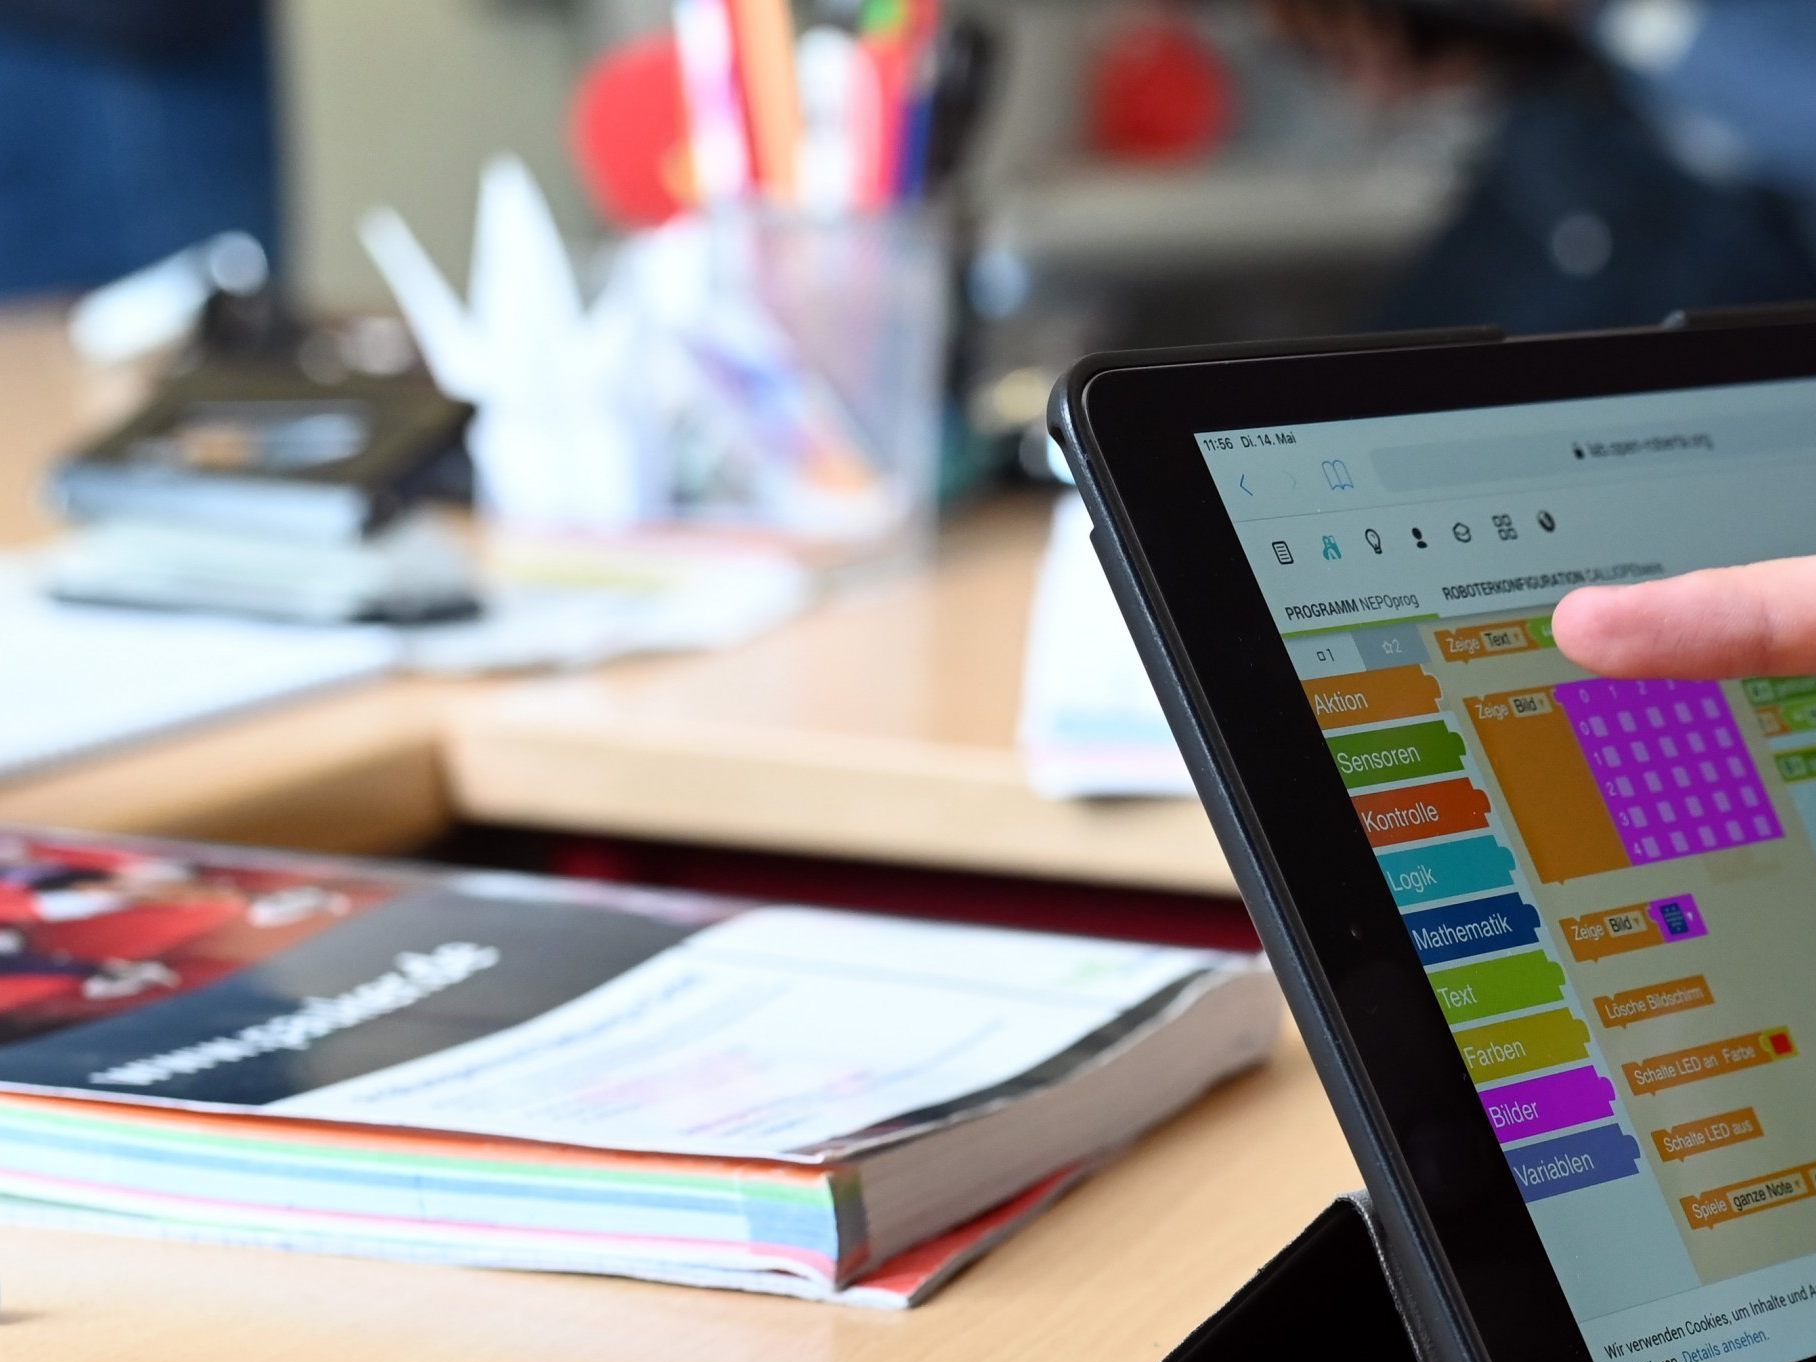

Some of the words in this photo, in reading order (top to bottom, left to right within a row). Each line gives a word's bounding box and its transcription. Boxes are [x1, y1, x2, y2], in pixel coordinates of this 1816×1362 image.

[1203, 437, 1234, 452] 11:56
[1240, 434, 1257, 448] Di.
[1257, 433, 1276, 447] 14.
[1275, 431, 1297, 445] Mai
[1442, 570, 1586, 601] ROBOTERKONFIGURATION
[1285, 599, 1360, 621] PROGRAMM
[1359, 594, 1420, 613] NEPOprog
[1447, 636, 1480, 655] Zeige
[1485, 631, 1512, 648] Text
[1314, 691, 1369, 716] Aktion
[1475, 701, 1510, 721] Zeige
[1512, 697, 1538, 714] Bild
[1337, 746, 1421, 774] Sensoren
[1361, 801, 1440, 833] Kontrolle
[1386, 864, 1438, 894] Logik
[1411, 912, 1514, 951] Mathematik
[1571, 921, 1605, 942] Zeige
[1607, 915, 1633, 934] Bild
[1437, 984, 1478, 1009] Text
[1605, 999, 1648, 1020] Lösche
[1645, 986, 1704, 1011] Bildschirm
[1463, 1038, 1528, 1069] Farben
[1634, 1063, 1677, 1086] Schalte
[1678, 1053, 1702, 1074] LED
[1701, 1053, 1719, 1068] an
[1722, 1044, 1757, 1063] Farbe
[1488, 1100, 1540, 1129] Bilder
[1663, 1130, 1706, 1153] Schalte
[1706, 1122, 1731, 1143] LED
[1731, 1119, 1754, 1135] aus
[1513, 1152, 1596, 1188] Variablen
[1691, 1196, 1729, 1220] Spiele
[1732, 1190, 1767, 1212] ganze
[1764, 1180, 1794, 1199] Note
[1603, 1342, 1626, 1361] Wir
[1625, 1325, 1687, 1354] verwenden
[1684, 1310, 1733, 1337] Cookies,
[1731, 1305, 1751, 1322] um
[1748, 1294, 1788, 1317] Inhalte
[1787, 1285, 1809, 1304] und
[1722, 1327, 1771, 1354] ansehen.
